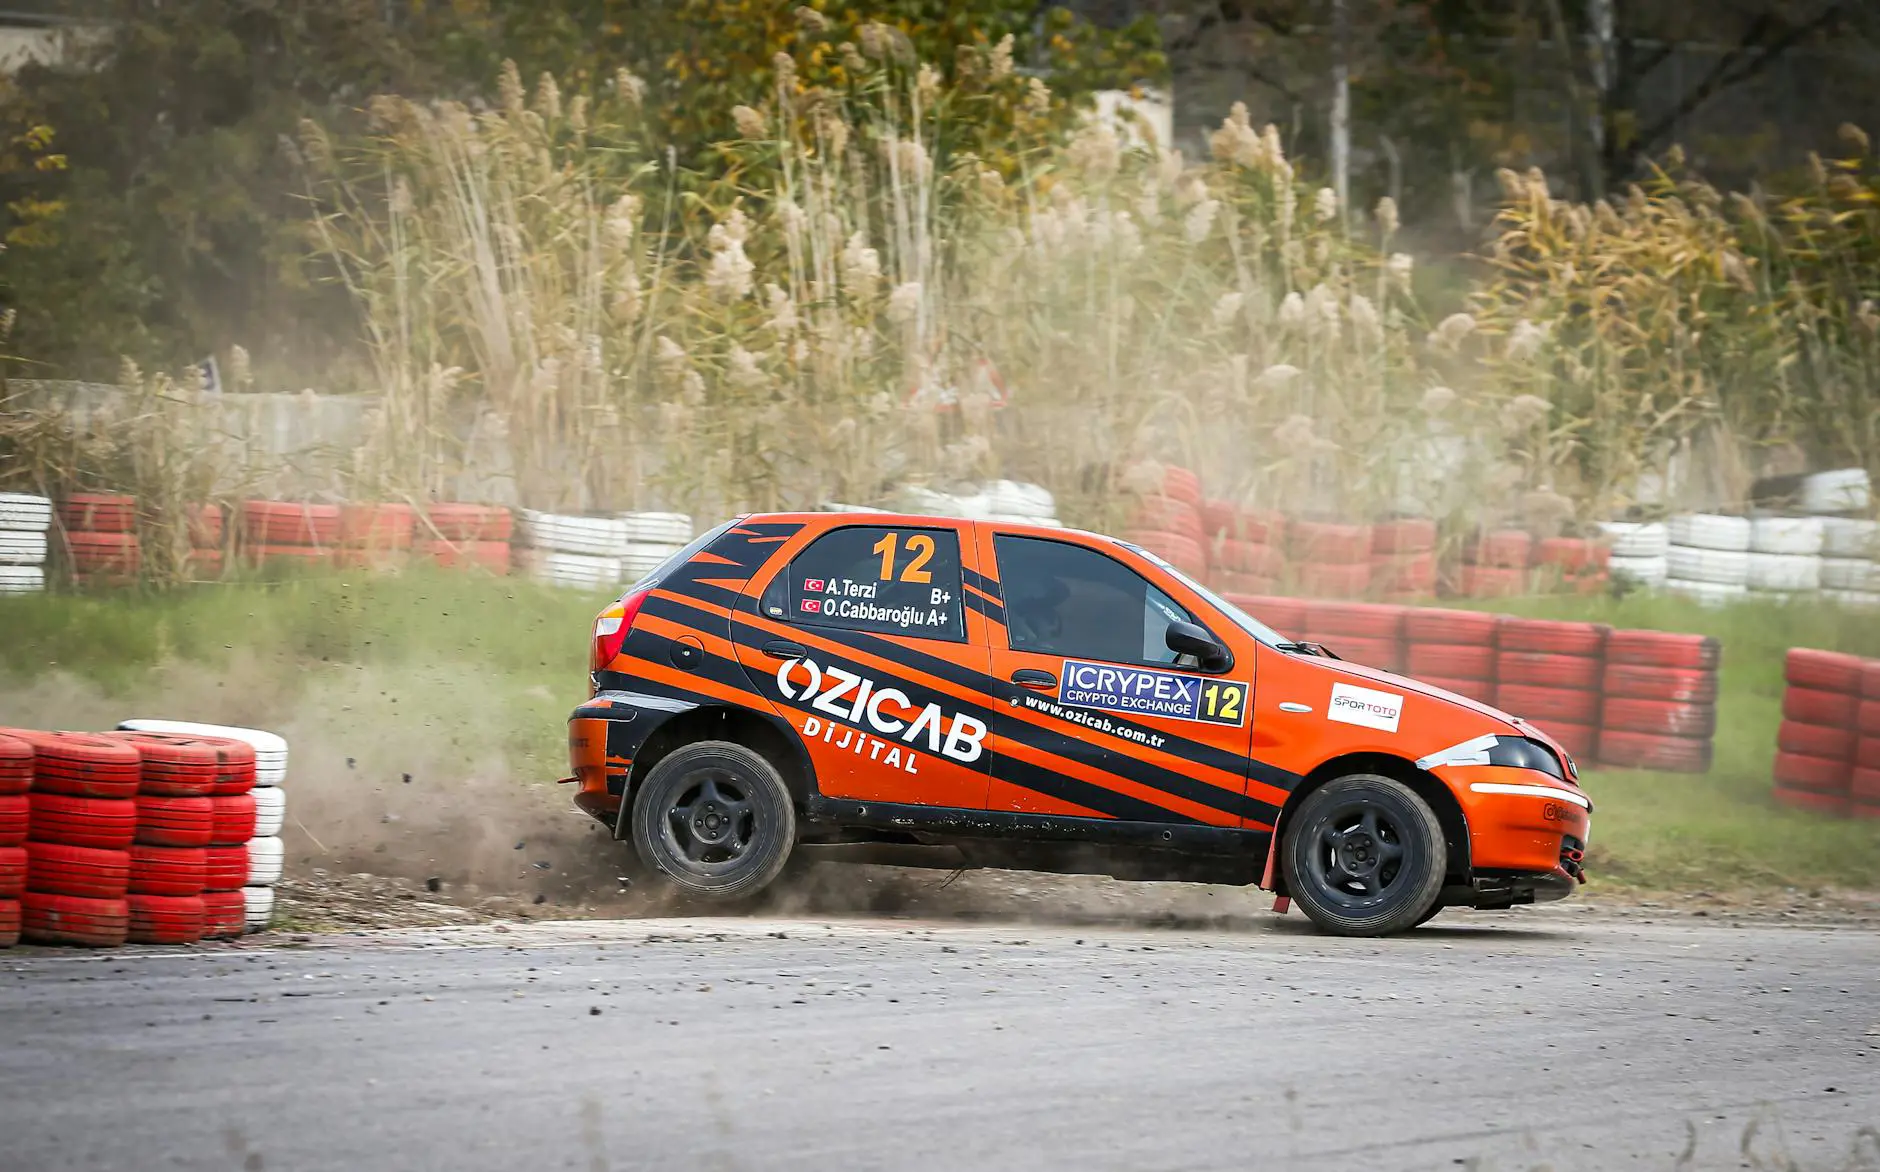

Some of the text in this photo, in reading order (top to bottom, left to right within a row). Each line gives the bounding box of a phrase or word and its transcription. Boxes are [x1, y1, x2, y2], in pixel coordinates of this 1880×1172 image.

[873, 532, 935, 584] 12
[825, 578, 951, 605] A.Terzi B+
[823, 599, 948, 628] O.Cabbaroğlu A+
[1068, 665, 1195, 702] ICRYPEX
[1066, 689, 1192, 715] CRYPTO EXCHANGE
[1205, 684, 1241, 719] 12
[1025, 696, 1166, 748] www.ozicab.com.tr
